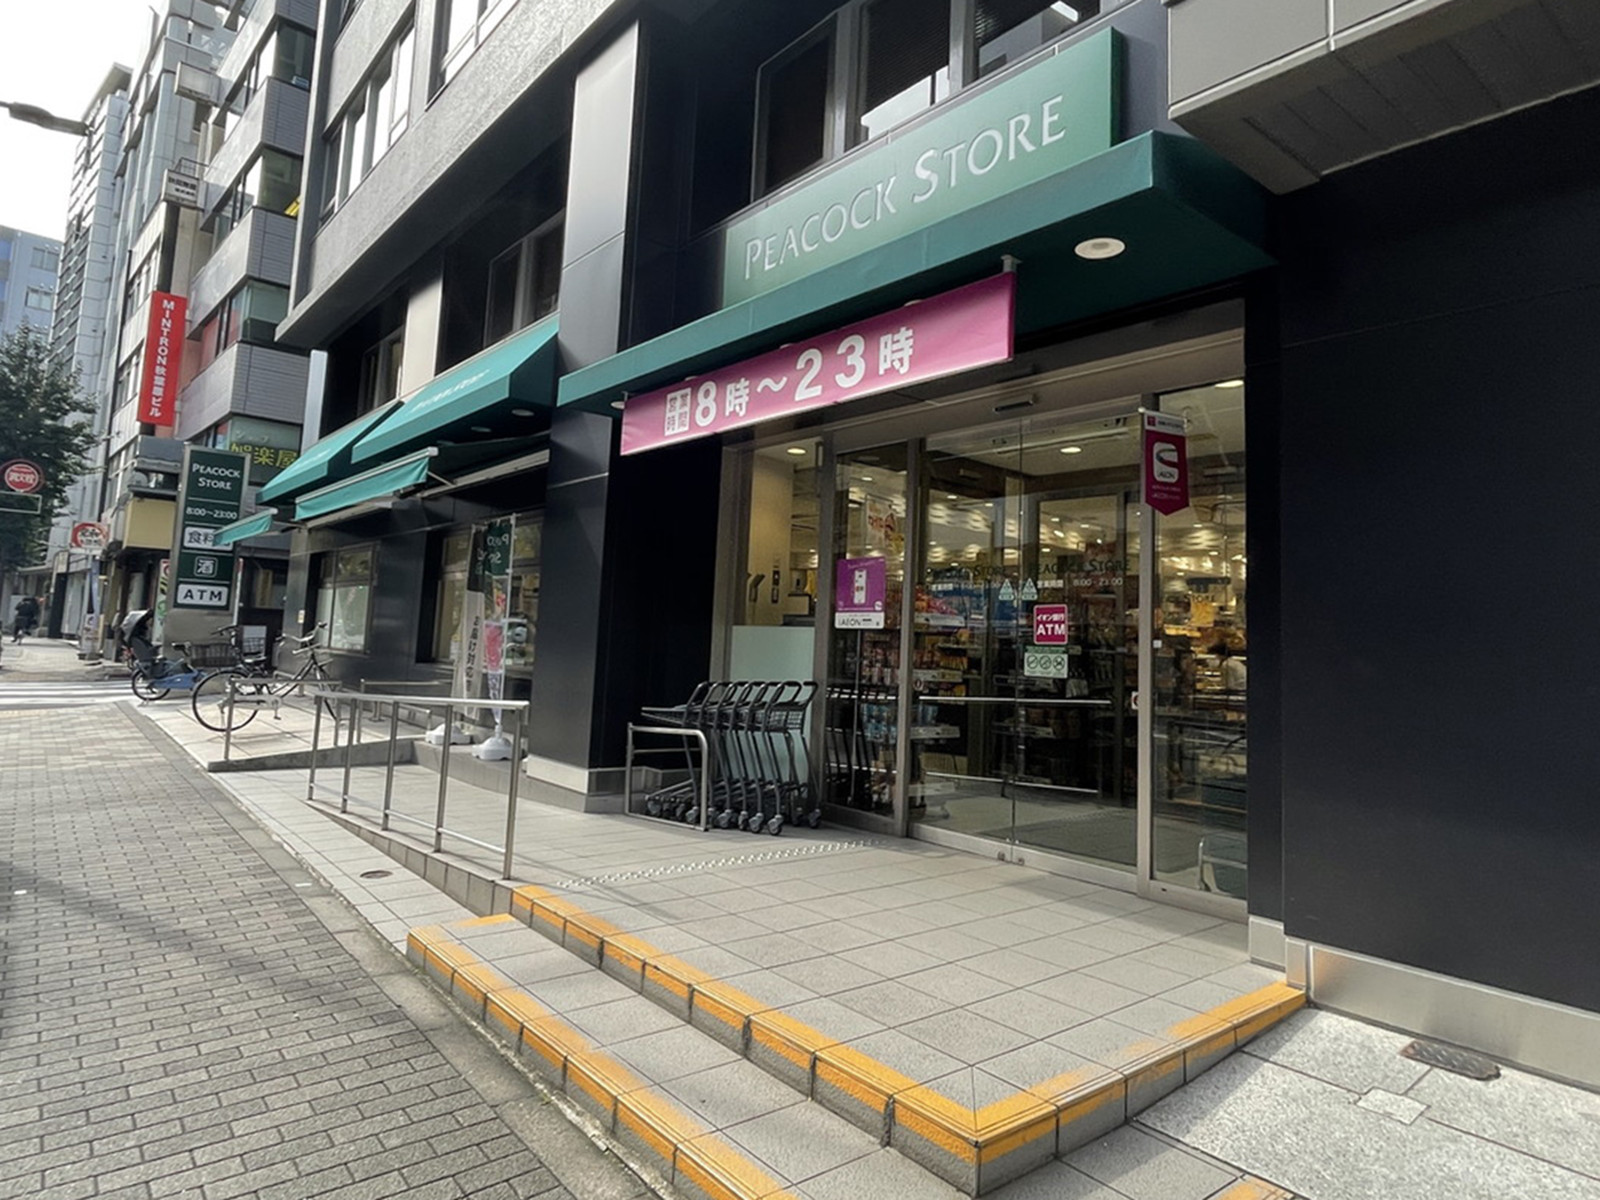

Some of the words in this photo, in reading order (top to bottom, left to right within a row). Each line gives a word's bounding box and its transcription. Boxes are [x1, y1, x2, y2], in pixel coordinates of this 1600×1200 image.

[744, 176, 897, 281] PEACOCK
[911, 95, 1067, 203] STORE
[192, 463, 240, 478] PEACOCK
[198, 477, 233, 490] STORE
[197, 559, 215, 574] 酒
[183, 589, 222, 602] ATM
[1036, 623, 1066, 636] ATM
